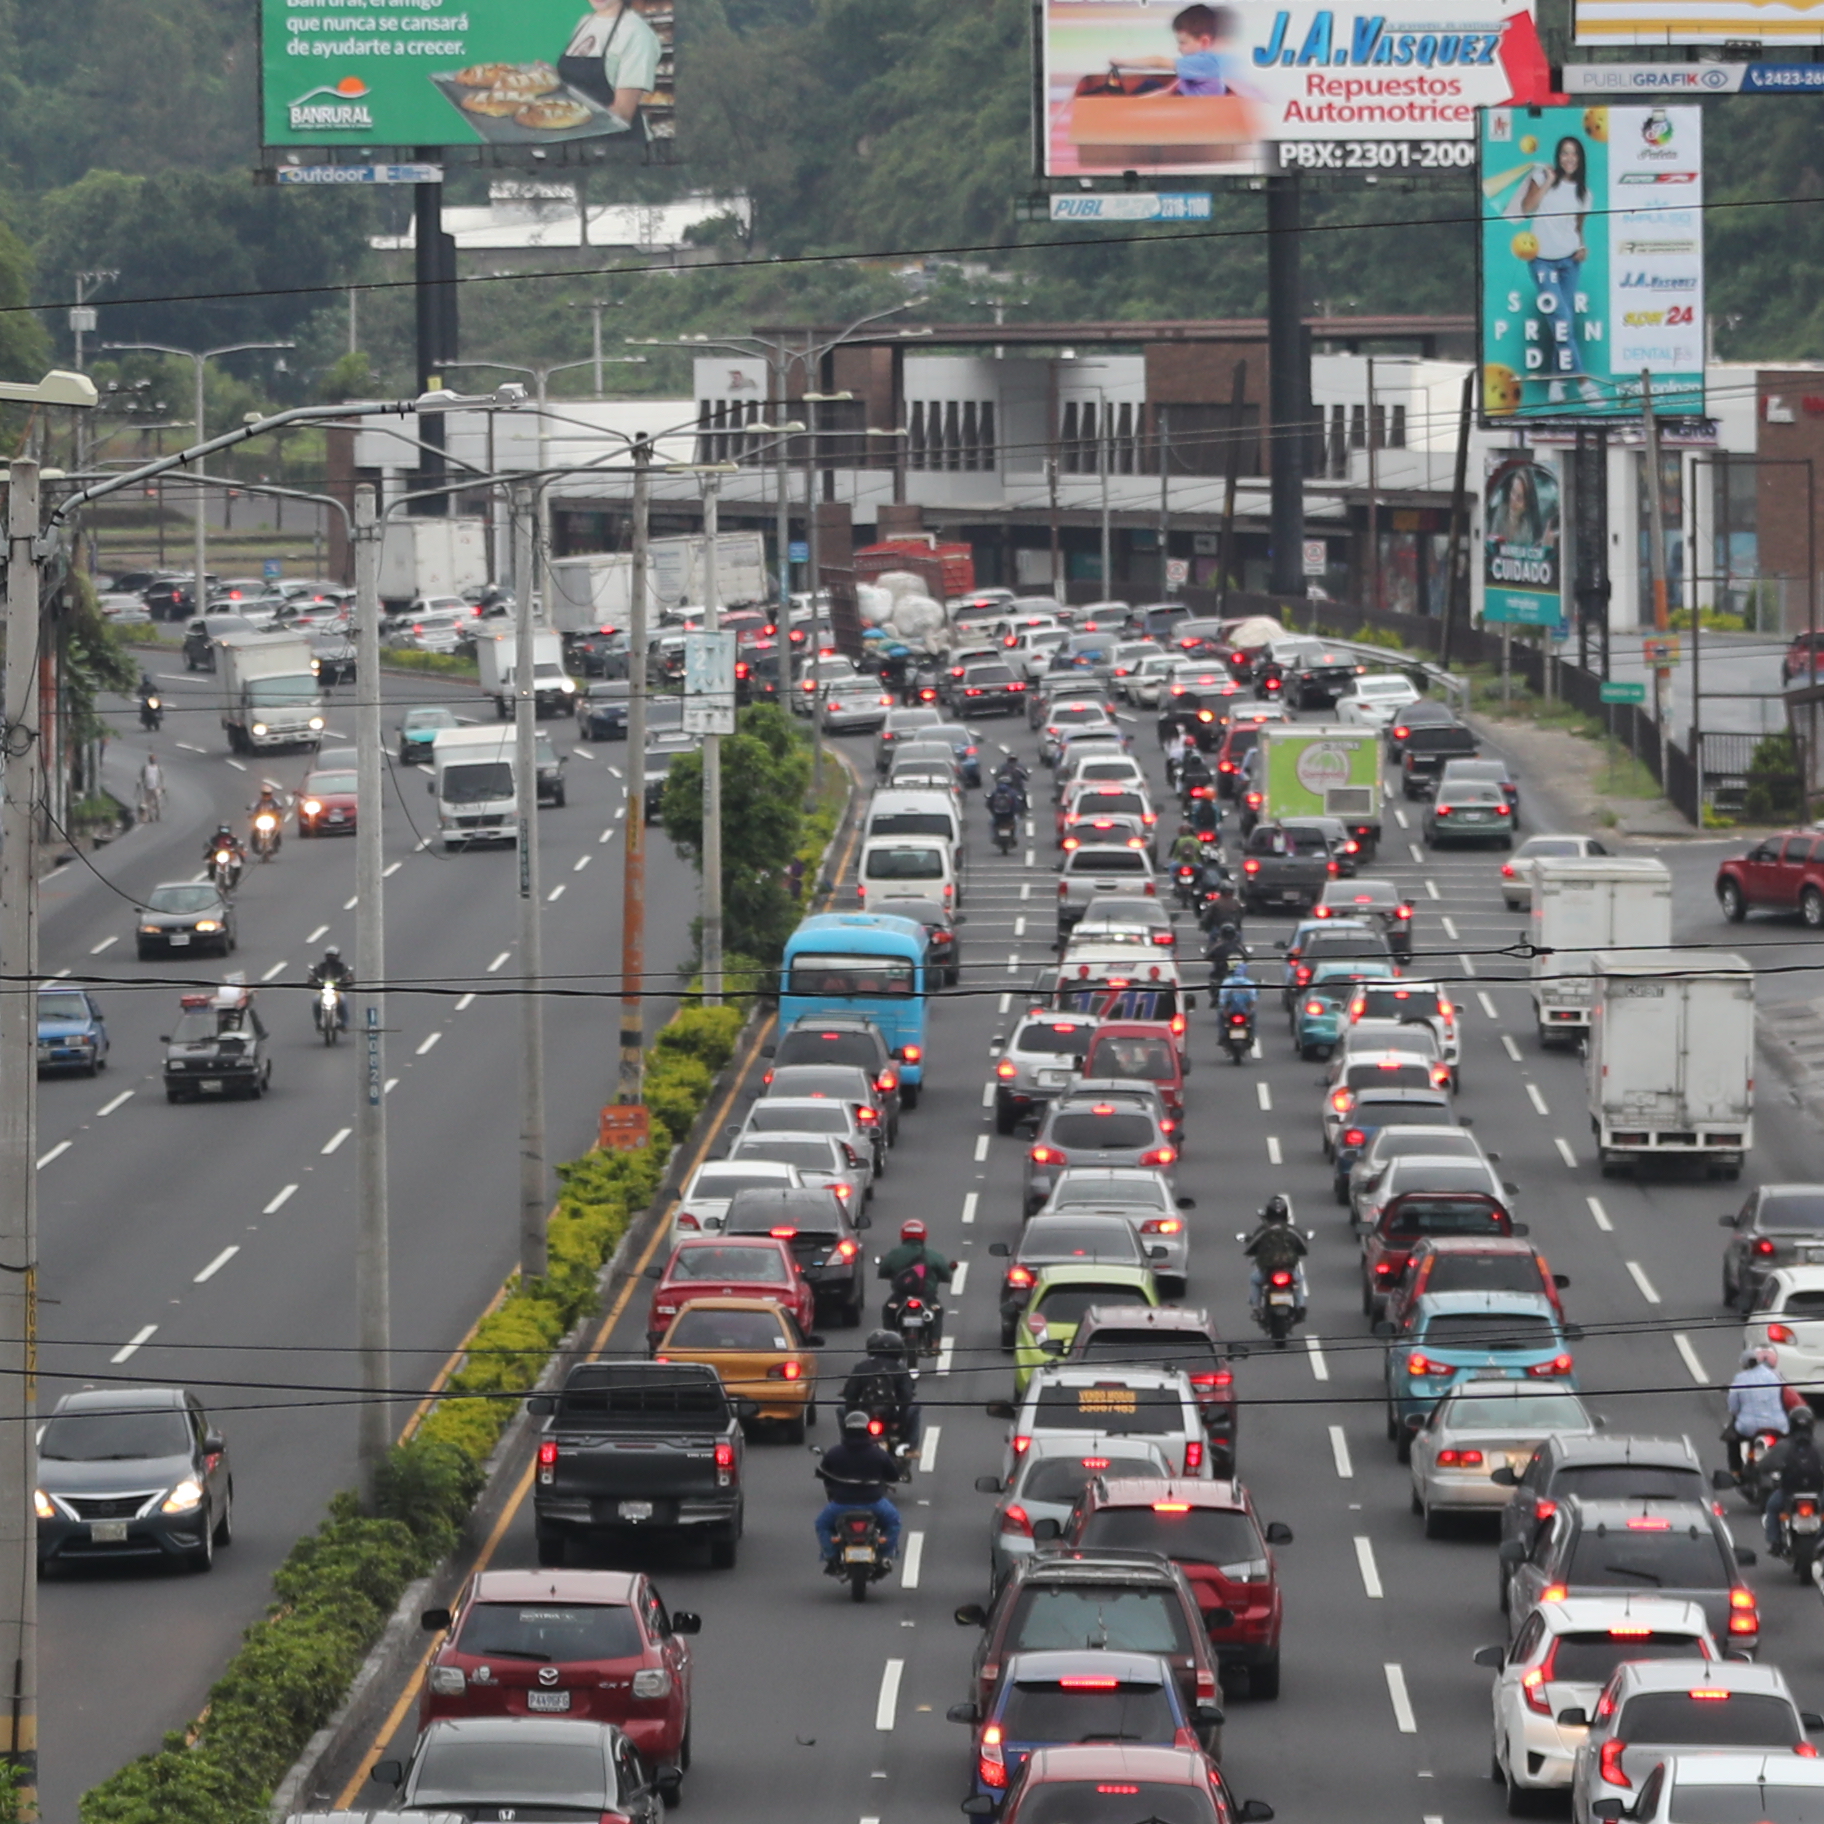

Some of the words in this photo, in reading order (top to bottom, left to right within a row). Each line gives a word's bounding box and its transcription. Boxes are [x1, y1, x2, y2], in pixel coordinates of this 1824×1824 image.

[286, 16, 320, 35] que
[322, 16, 376, 32] nunca
[379, 16, 398, 32] se
[401, 13, 469, 32] cansará
[286, 37, 310, 56] de
[312, 37, 391, 59] ayudarte
[394, 41, 404, 56] a
[407, 41, 466, 56] crecer.
[1305, 74, 1462, 101] Repuestos
[1583, 72, 1699, 87] PUBLIGRAFIK
[290, 106, 373, 124] BANRURAL
[1279, 142, 1343, 168] PBX:
[1345, 142, 1474, 168] 2301-200
[1492, 558, 1552, 585] CUIDADO
